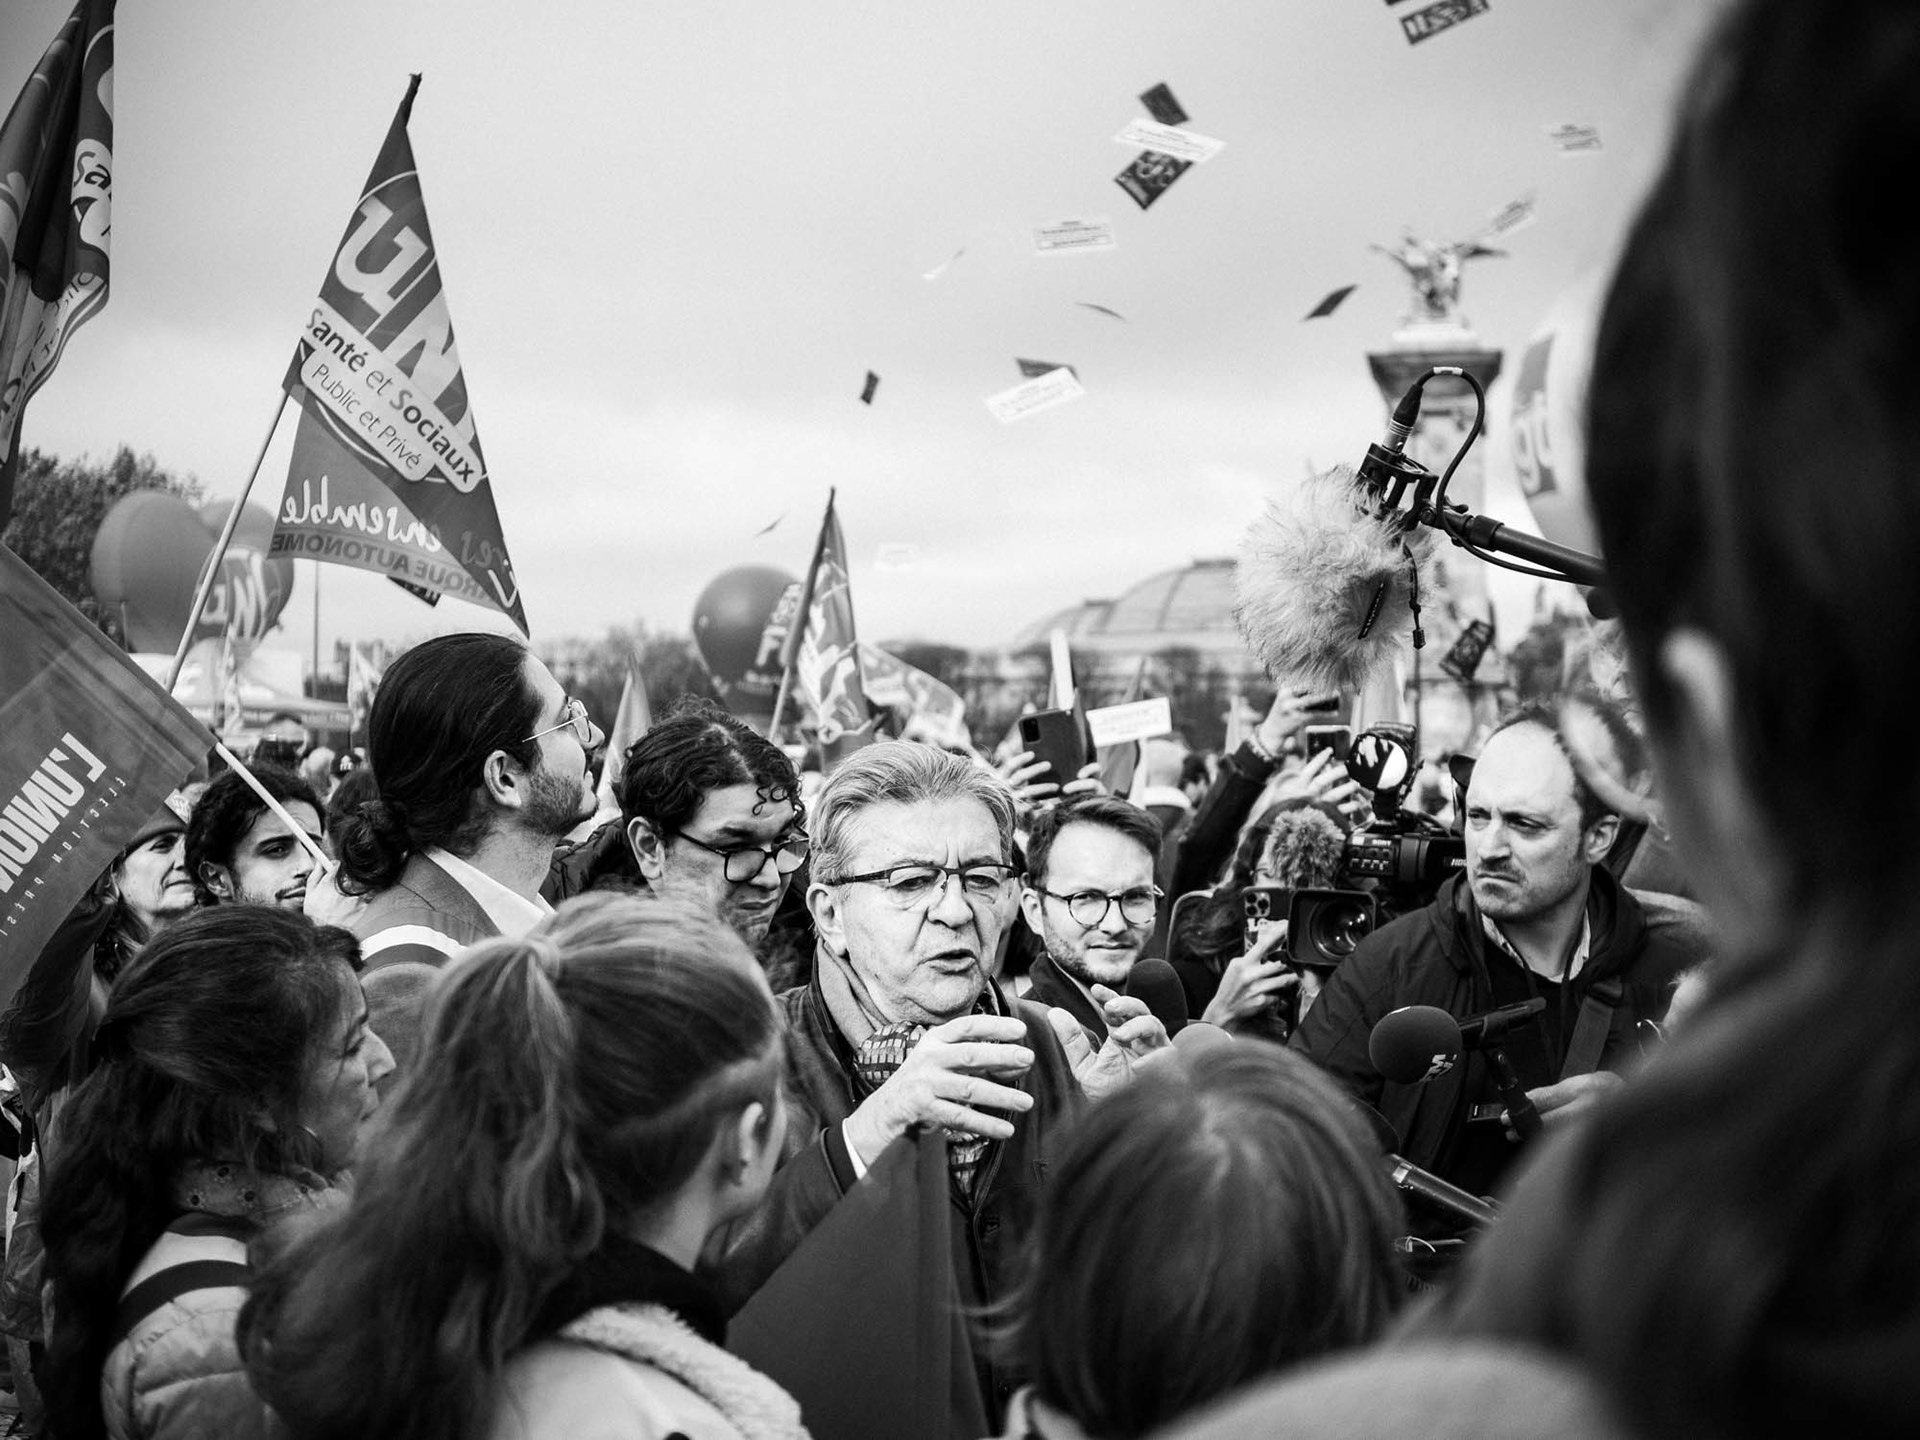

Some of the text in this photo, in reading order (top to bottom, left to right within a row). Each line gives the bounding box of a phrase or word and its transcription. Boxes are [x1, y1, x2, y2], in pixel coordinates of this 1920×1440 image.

[305, 308, 475, 484] Santé et Sociaux
[311, 363, 422, 470] Public et Privé
